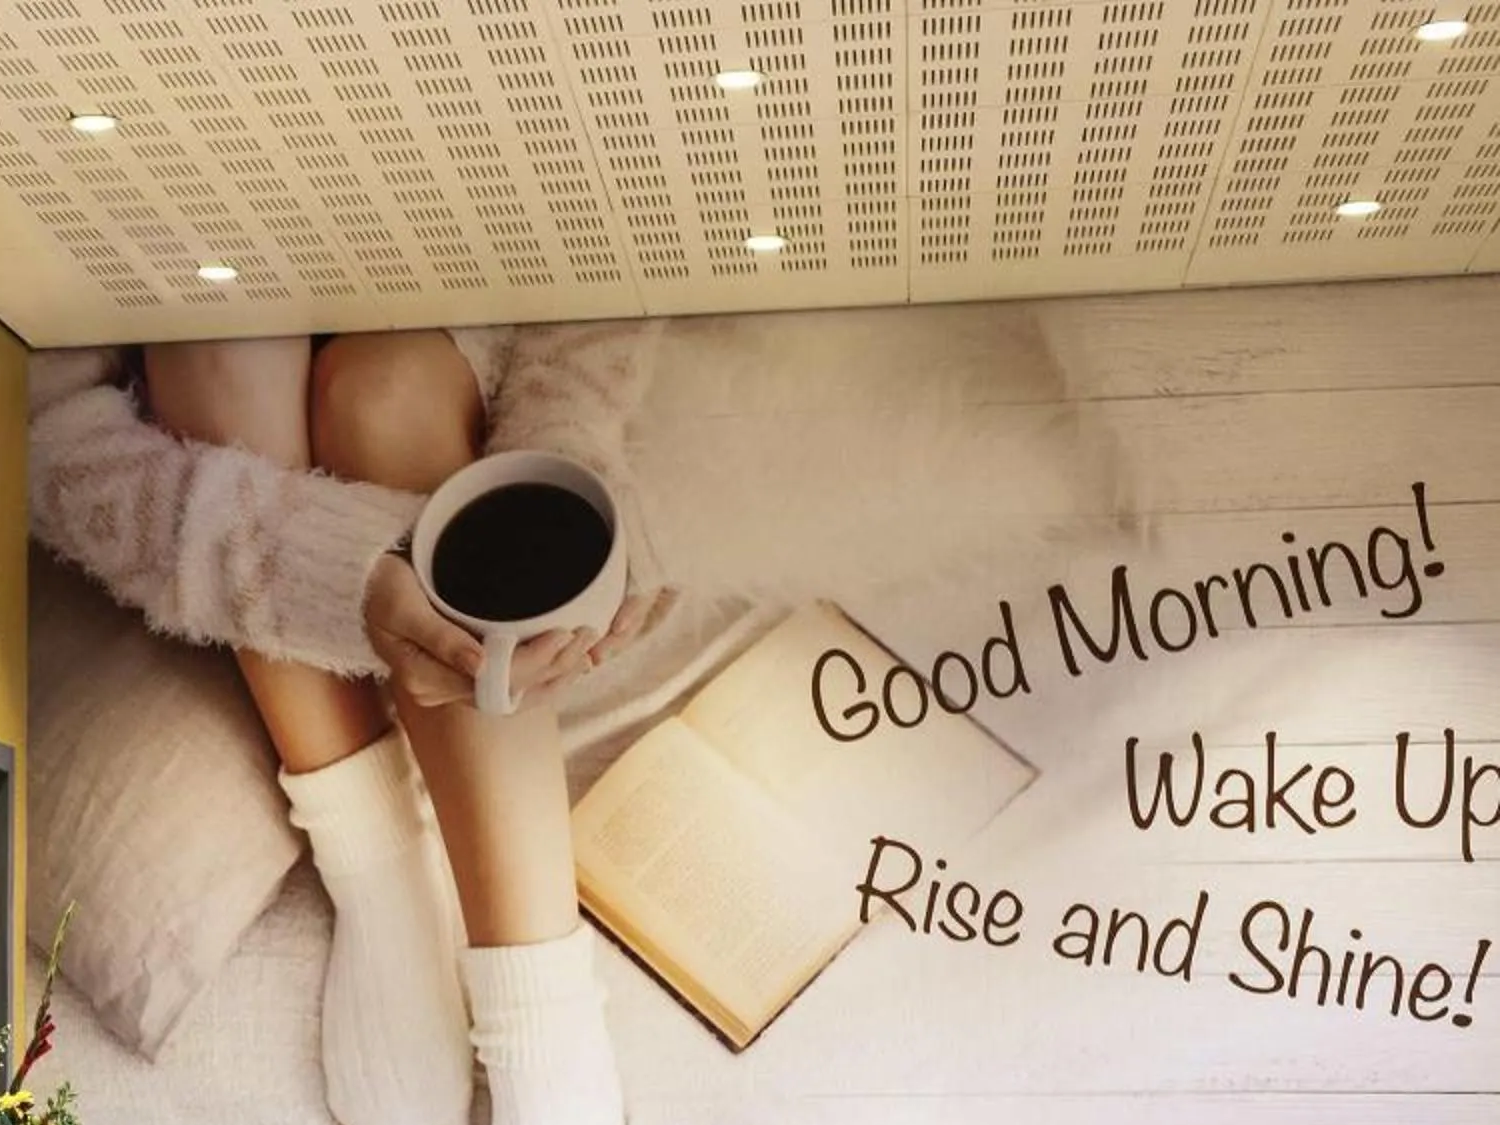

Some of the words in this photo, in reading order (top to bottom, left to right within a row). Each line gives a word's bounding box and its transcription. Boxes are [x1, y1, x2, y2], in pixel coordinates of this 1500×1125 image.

[811, 599, 1031, 742] Good
[1047, 481, 1446, 676] Morning!
[1125, 731, 1357, 834] Wake
[1395, 728, 1500, 862] Up
[856, 834, 1024, 947] Rise
[1052, 891, 1208, 982] and
[1229, 900, 1491, 1027] Shine!
